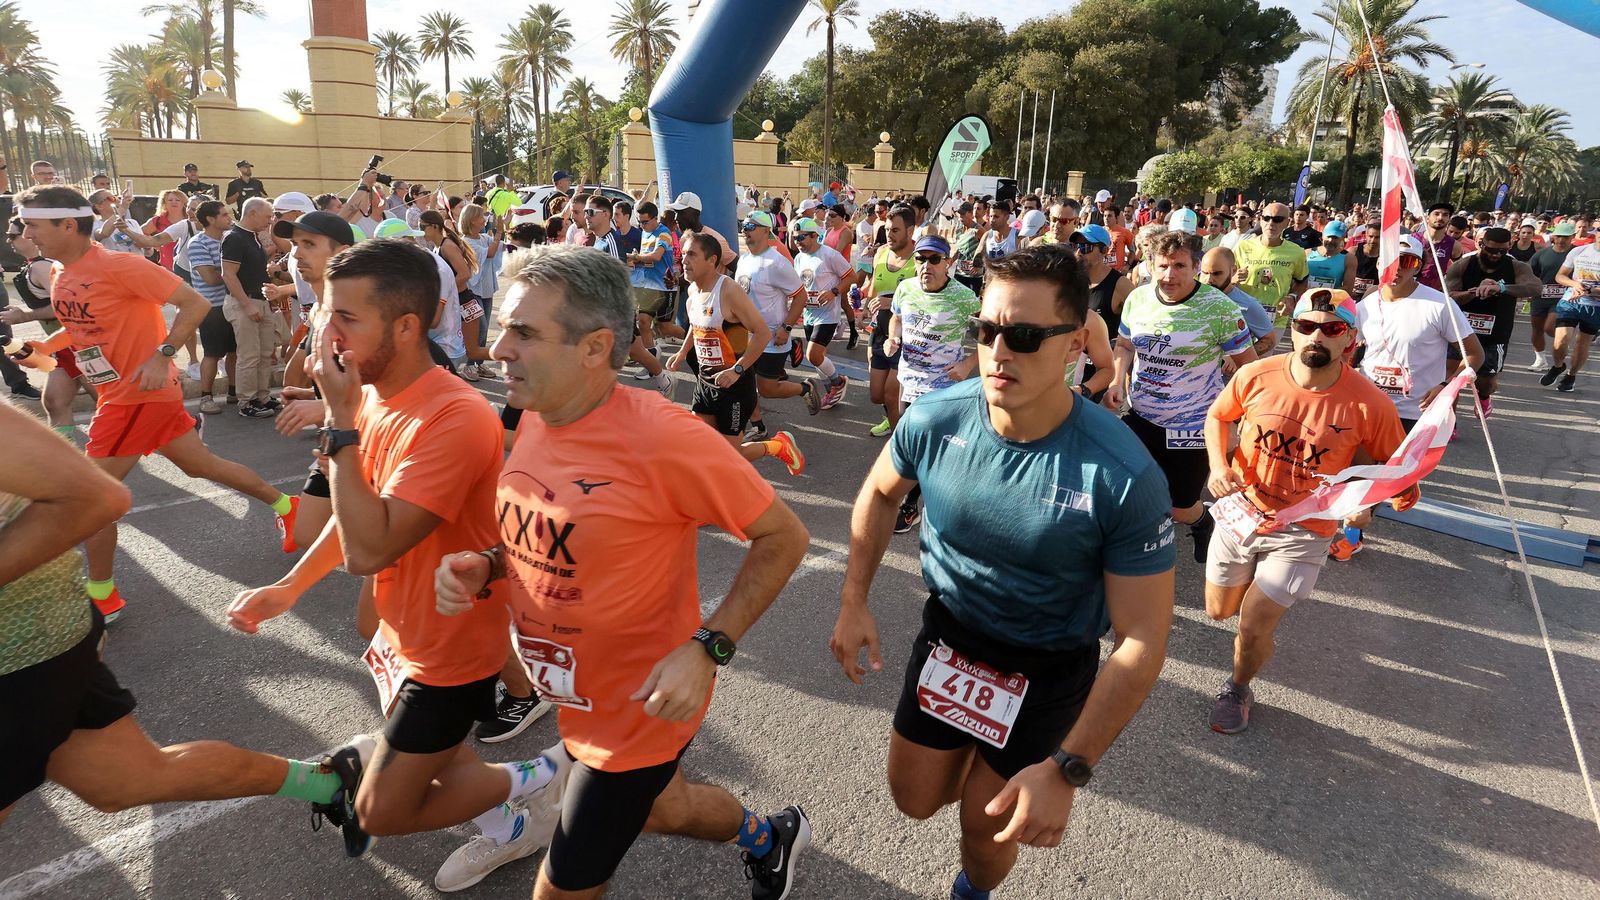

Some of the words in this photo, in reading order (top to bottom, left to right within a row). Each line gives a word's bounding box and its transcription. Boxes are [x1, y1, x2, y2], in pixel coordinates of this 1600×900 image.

[950, 151, 976, 159] SPORT
[1144, 366, 1168, 377] JEREZ
[1374, 375, 1397, 386] 278
[559, 569, 576, 578] DE
[941, 673, 995, 711] 418
